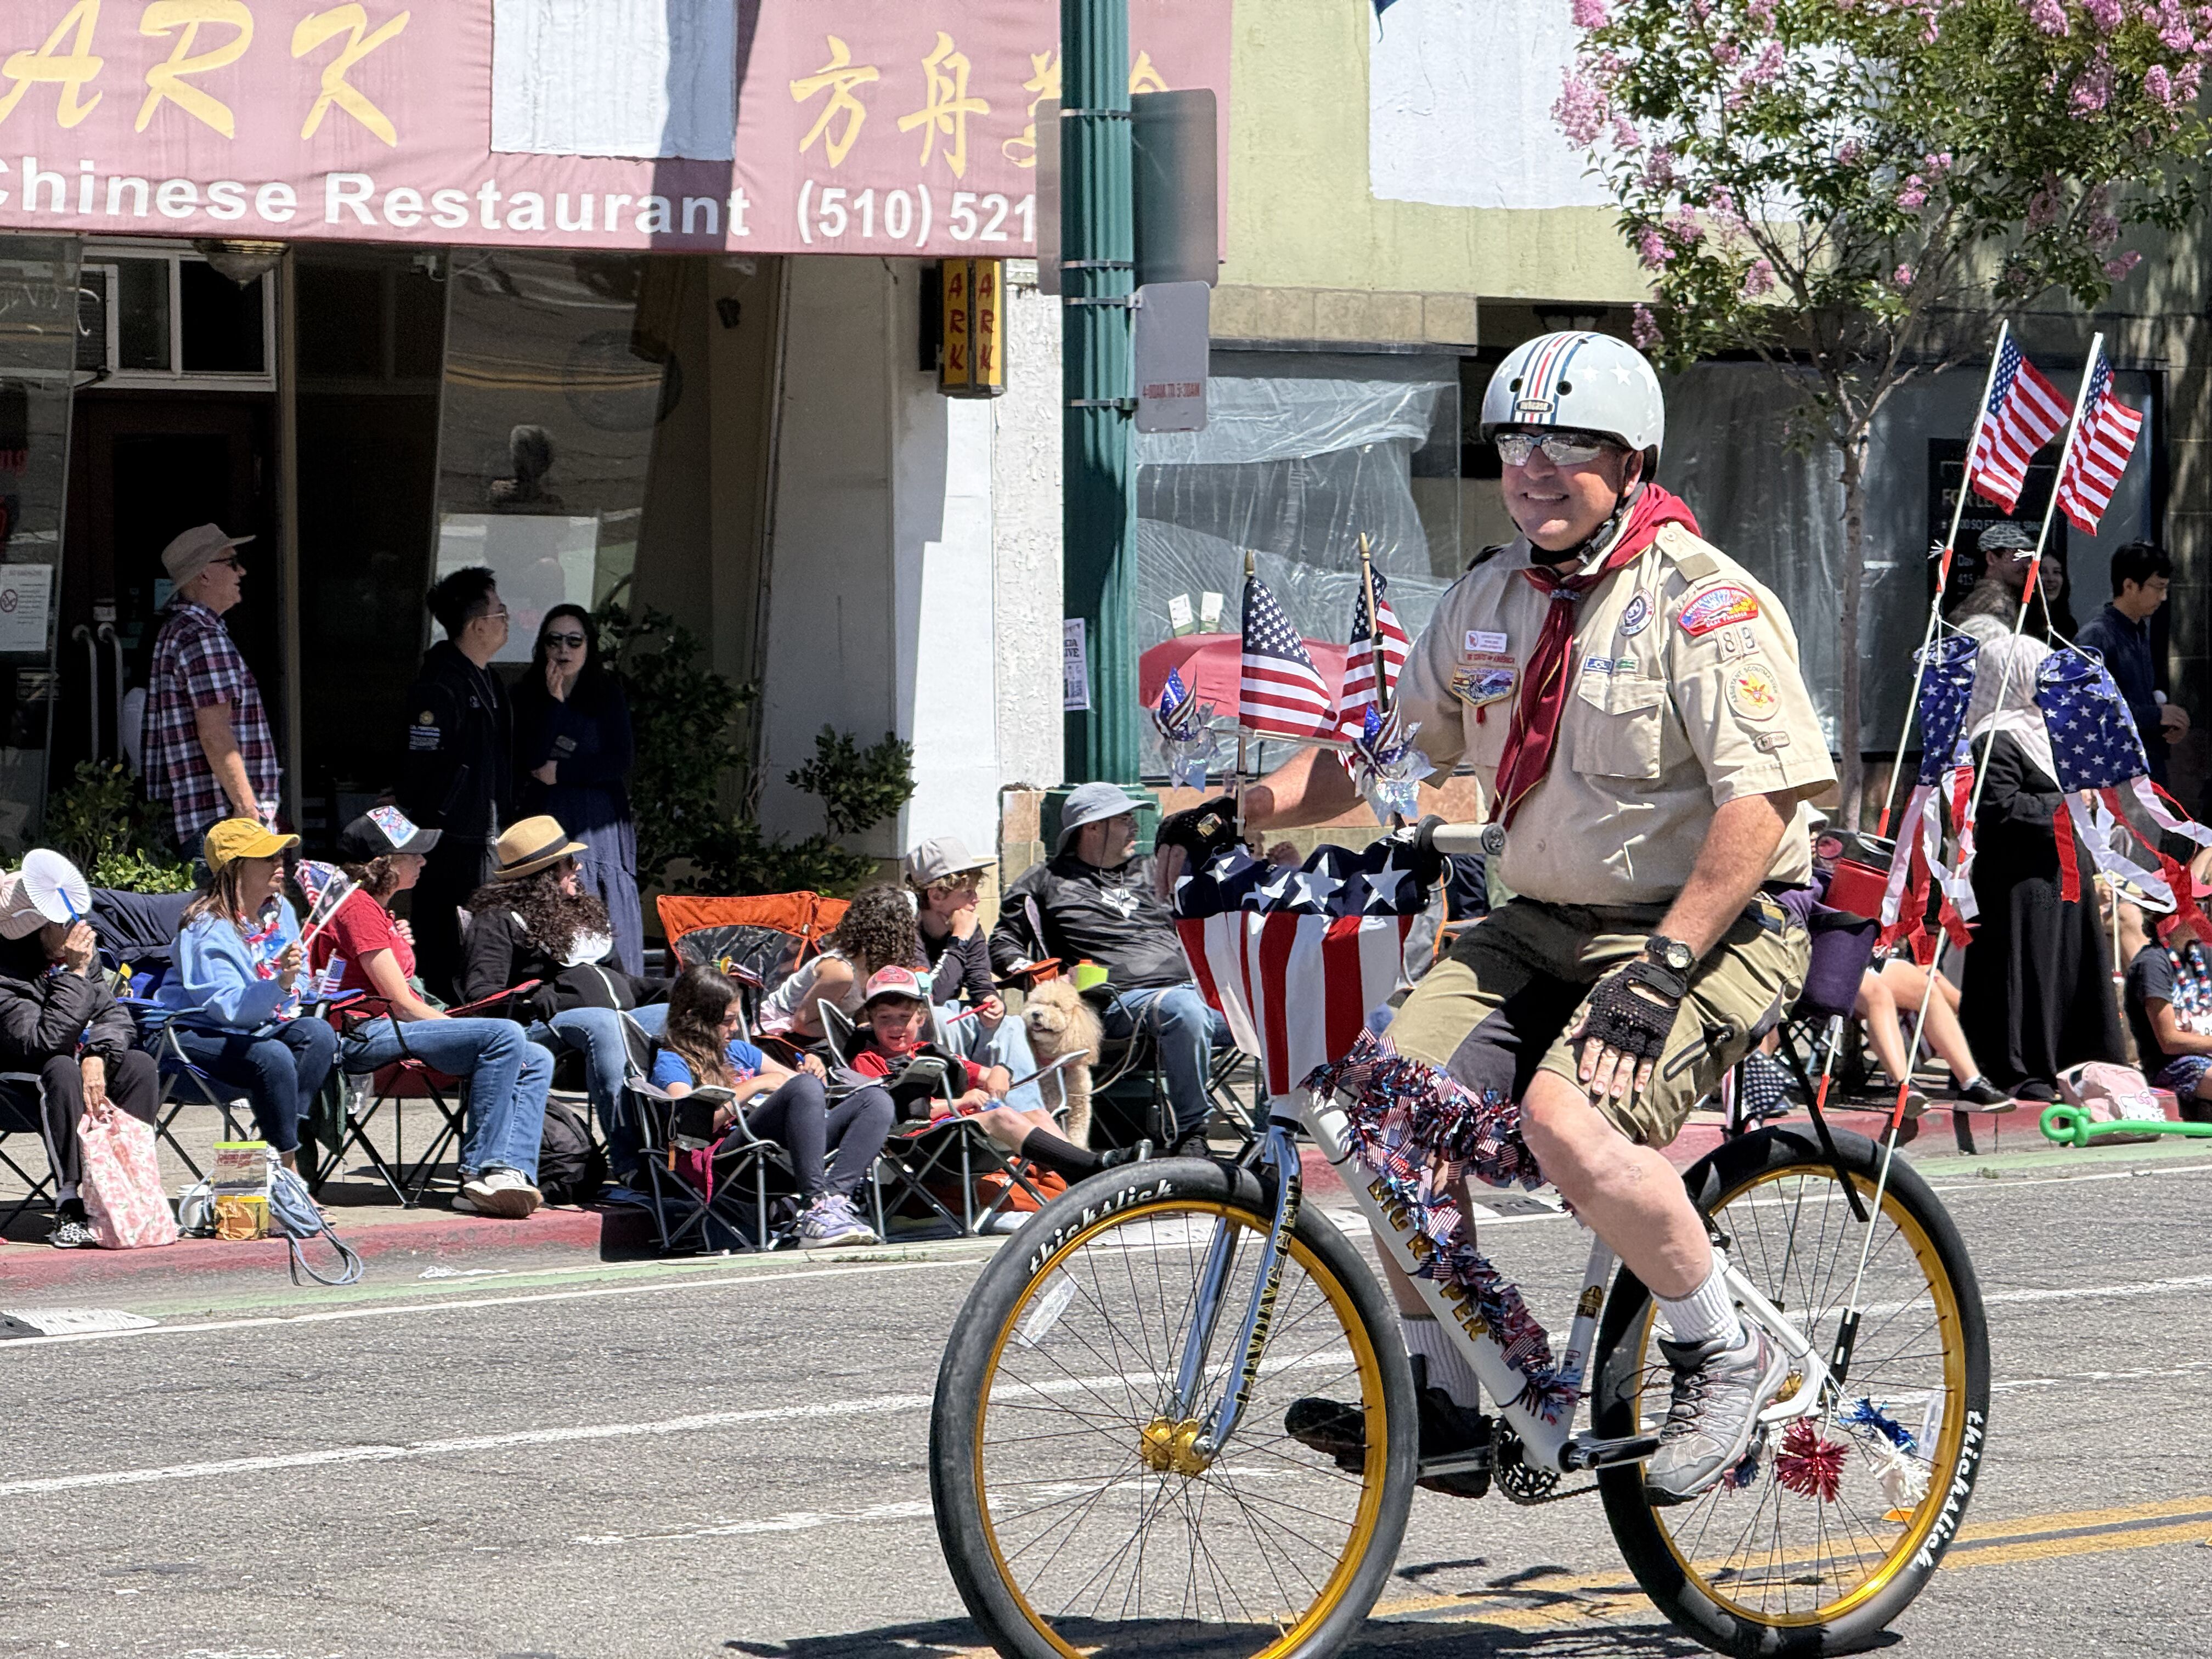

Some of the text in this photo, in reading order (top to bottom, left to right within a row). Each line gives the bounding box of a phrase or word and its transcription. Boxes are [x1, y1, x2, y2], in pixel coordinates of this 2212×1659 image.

[0, 0, 410, 148] ARK
[0, 156, 750, 236] hinese Restaurant
[797, 179, 933, 248] (510)
[947, 272, 966, 371] ARK
[978, 272, 995, 371] ARK
[1029, 1178, 1173, 1276] thickslick
[1407, 1231, 1490, 1342] RPER
[1914, 1410, 1984, 1567] thickslick
